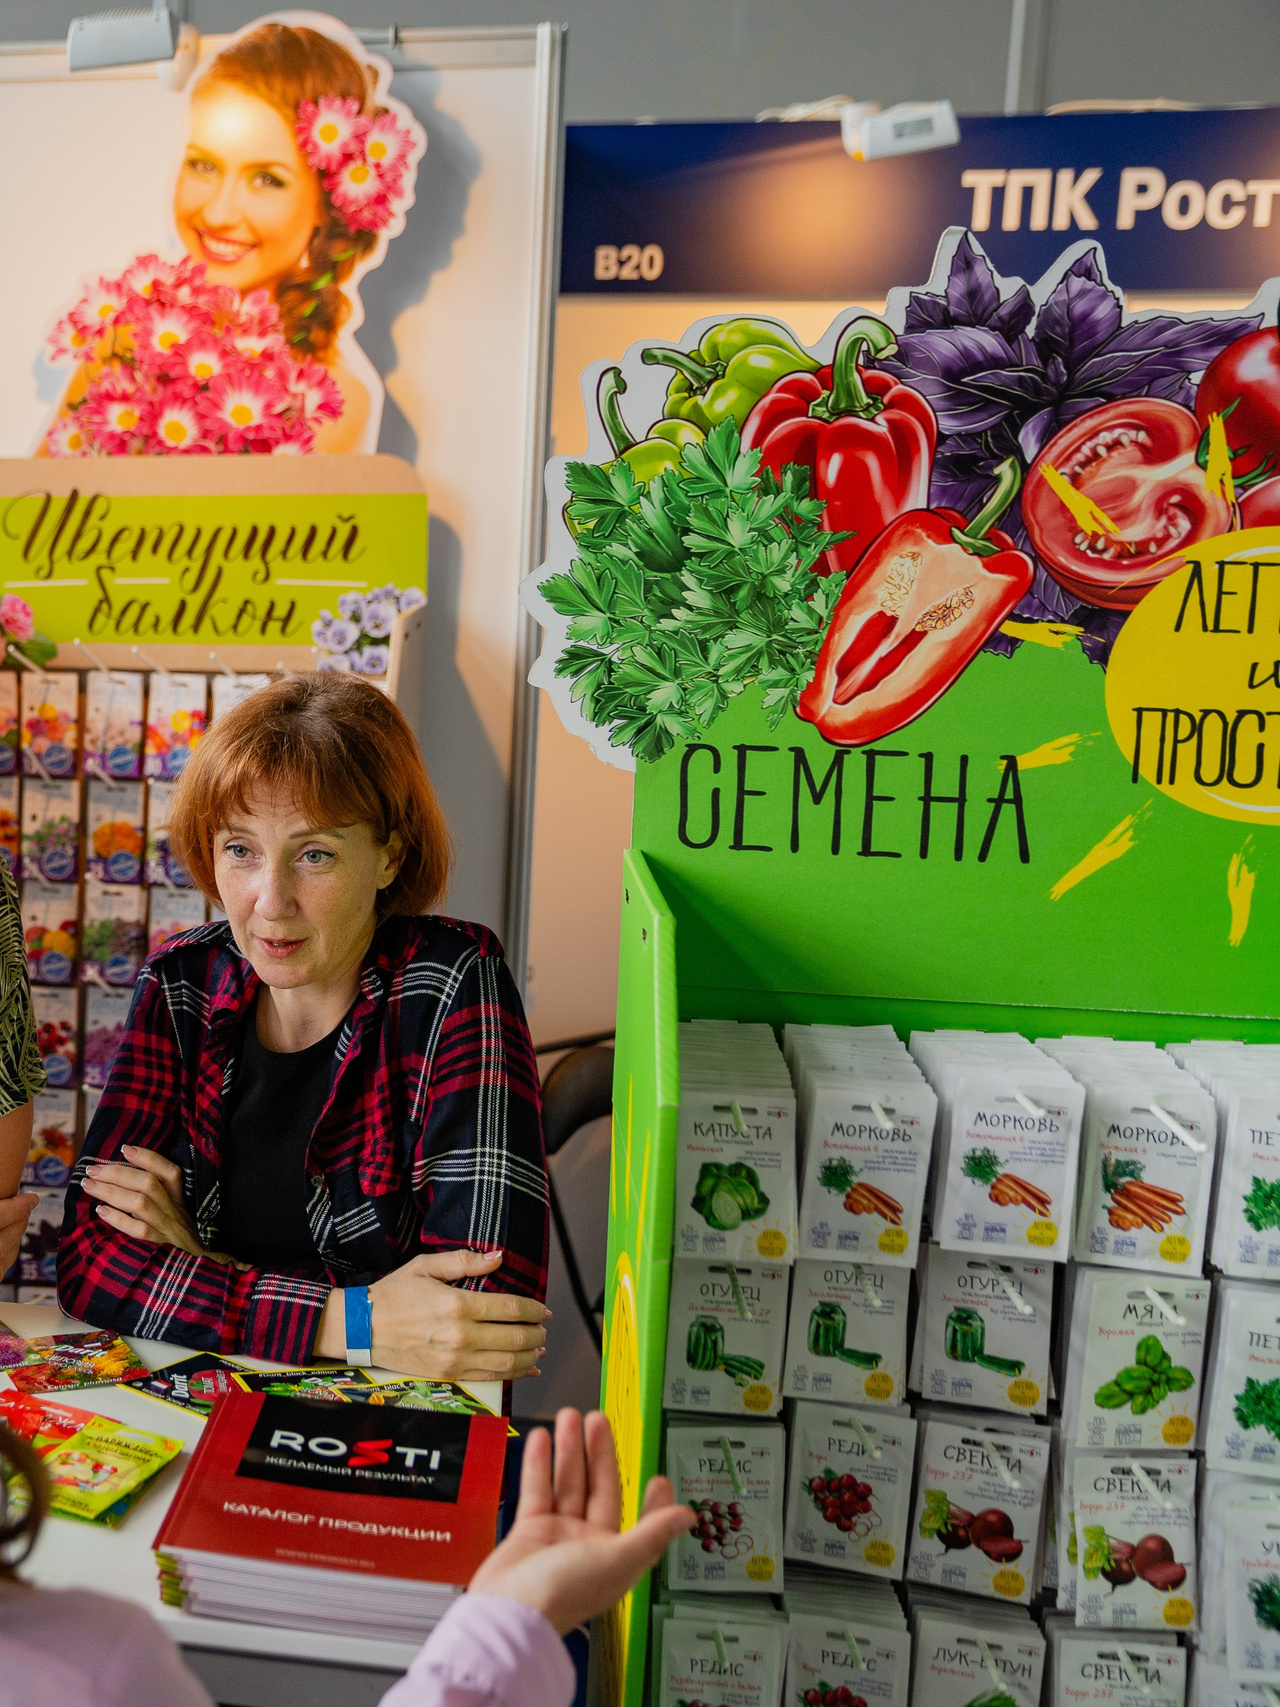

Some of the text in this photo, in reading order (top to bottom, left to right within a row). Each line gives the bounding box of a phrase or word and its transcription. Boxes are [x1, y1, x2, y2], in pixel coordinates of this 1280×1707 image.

[960, 166, 1280, 231] ТПК Рост
[593, 243, 664, 281] B20
[2, 488, 367, 594] Цветущий
[86, 565, 303, 639] балкон
[1173, 560, 1280, 636] ЛЕГ
[677, 743, 1032, 865] СЕМЕНА
[831, 1121, 912, 1143] МОРКОВЬ
[973, 1111, 1060, 1133] МОРКОВЬ
[83, 1377, 123, 1387] plumosa
[170, 1373, 189, 1399] Darit
[265, 1454, 435, 1485] ЖЕЛАЕМЫЙ РЕЗУЛЬТАТ
[270, 1429, 441, 1470] ROSTI
[223, 1501, 453, 1543] КАТАЛОГ ПРОДУКЦИИ
